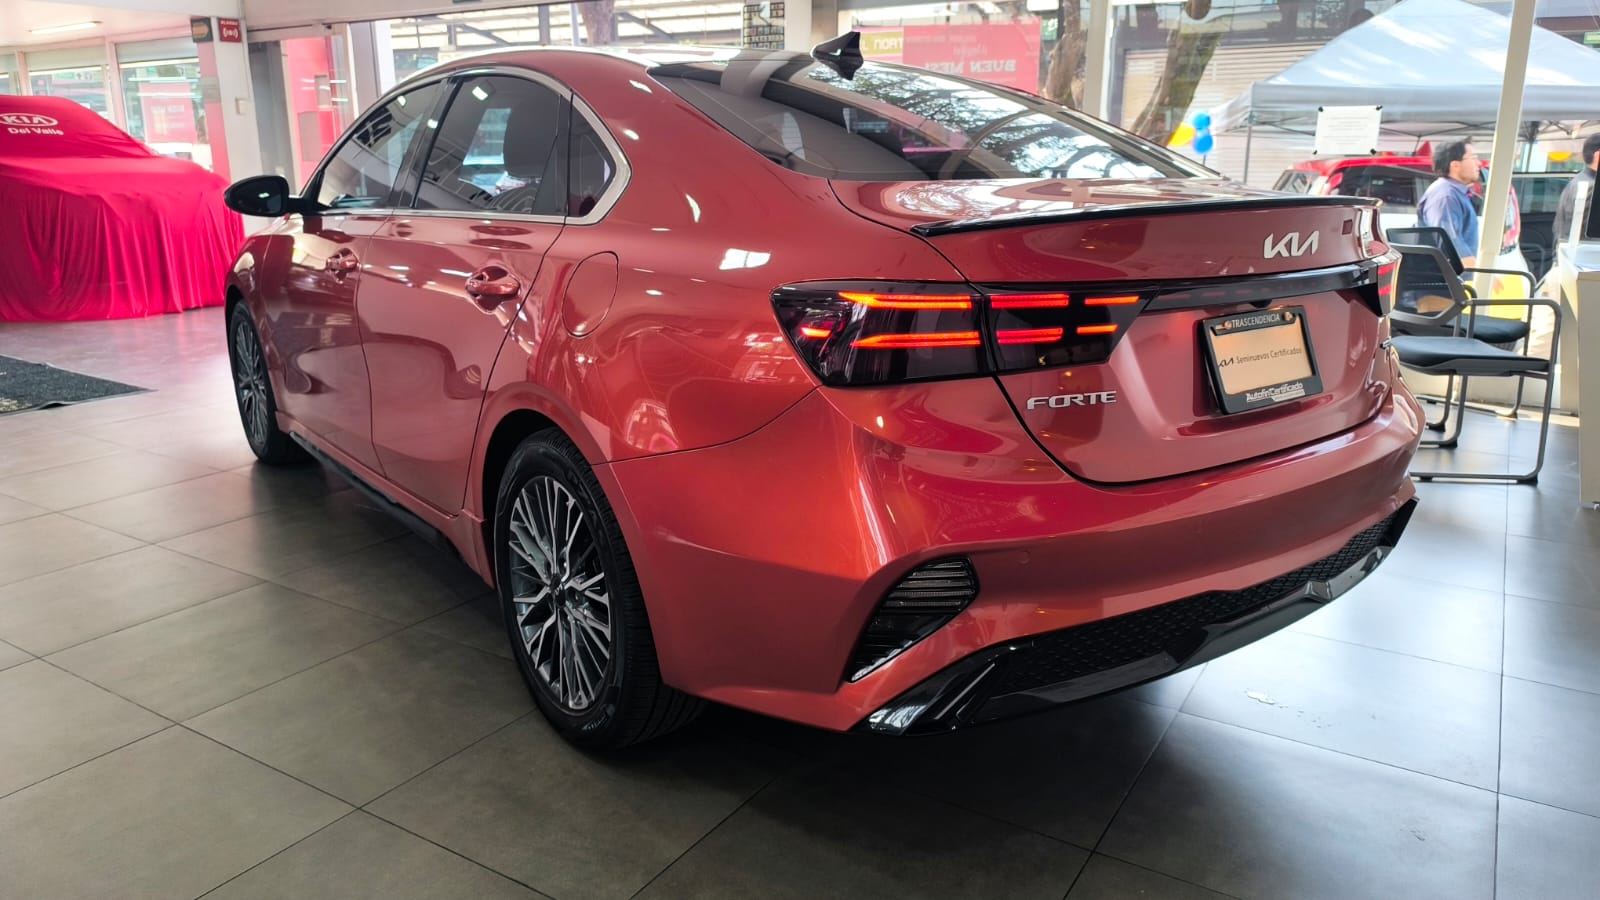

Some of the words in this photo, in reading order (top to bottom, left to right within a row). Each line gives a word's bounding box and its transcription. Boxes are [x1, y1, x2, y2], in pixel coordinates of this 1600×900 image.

[2, 115, 49, 124] KIA
[8, 127, 31, 135] Del
[31, 127, 64, 136] Valle
[1263, 230, 1320, 259] KIA
[1232, 313, 1280, 328] TRASCENDENCIA
[1236, 352, 1270, 363] Seminuevos
[1270, 347, 1303, 358] Certificados
[1026, 390, 1117, 410] FORTE
